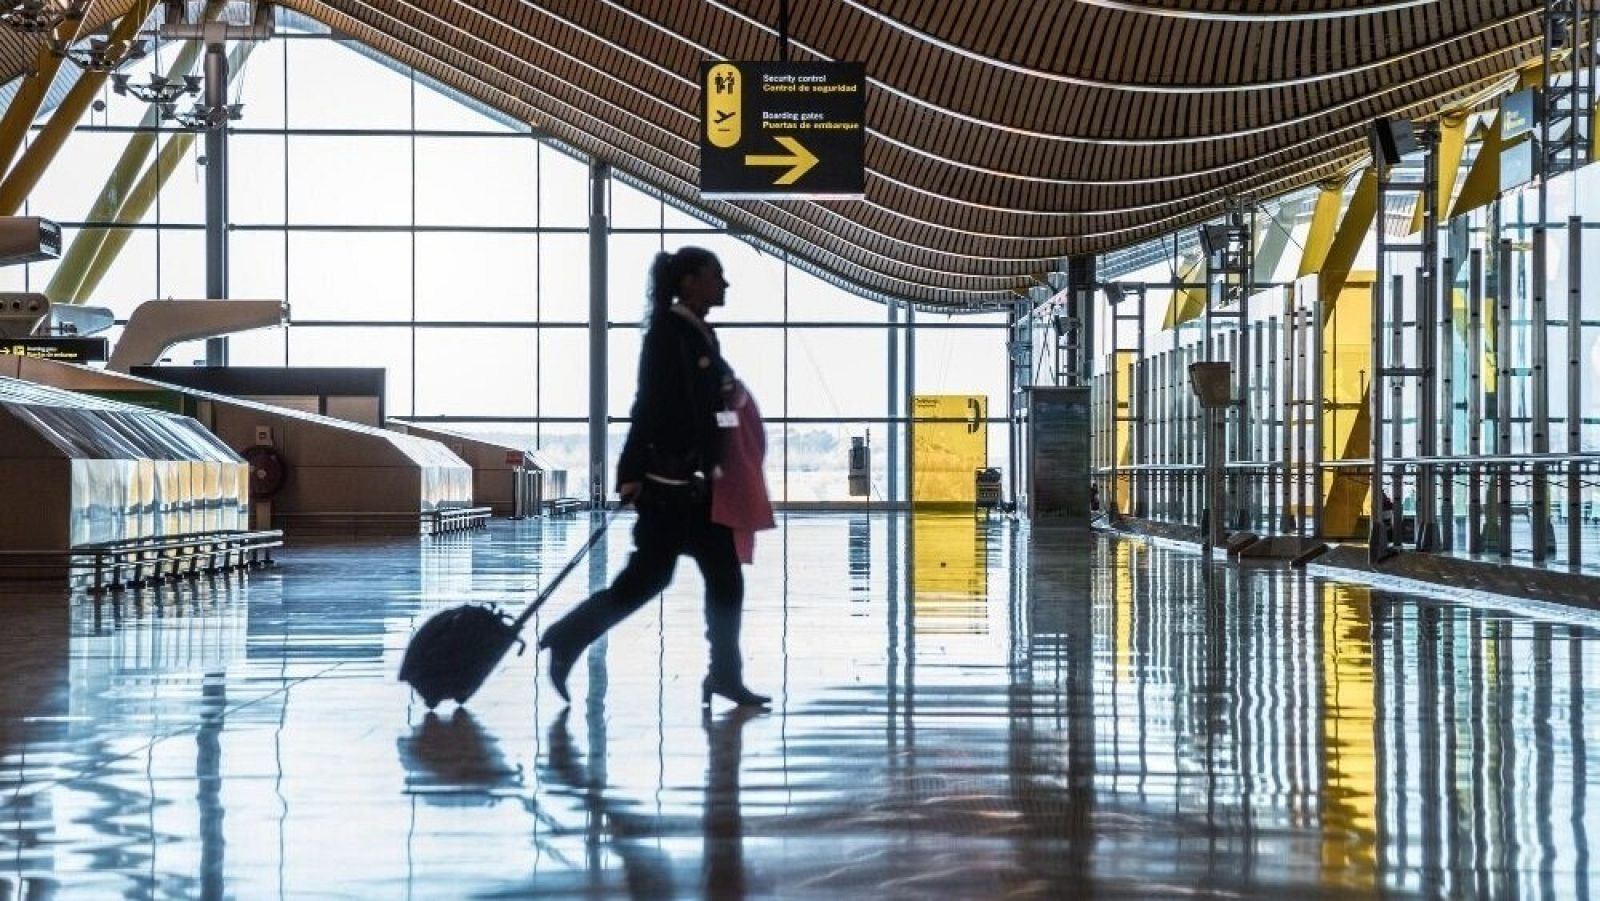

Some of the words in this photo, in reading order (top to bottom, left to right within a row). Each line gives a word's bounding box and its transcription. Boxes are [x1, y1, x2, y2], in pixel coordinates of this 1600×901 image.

[763, 74, 796, 83] Security
[763, 84, 796, 92] Control
[798, 84, 811, 92] de
[813, 84, 857, 93] seguridad
[763, 112, 799, 120] Boarding
[801, 112, 824, 120] gates
[763, 121, 798, 129] Puertas
[800, 121, 812, 129] de
[814, 121, 860, 130] embarque
